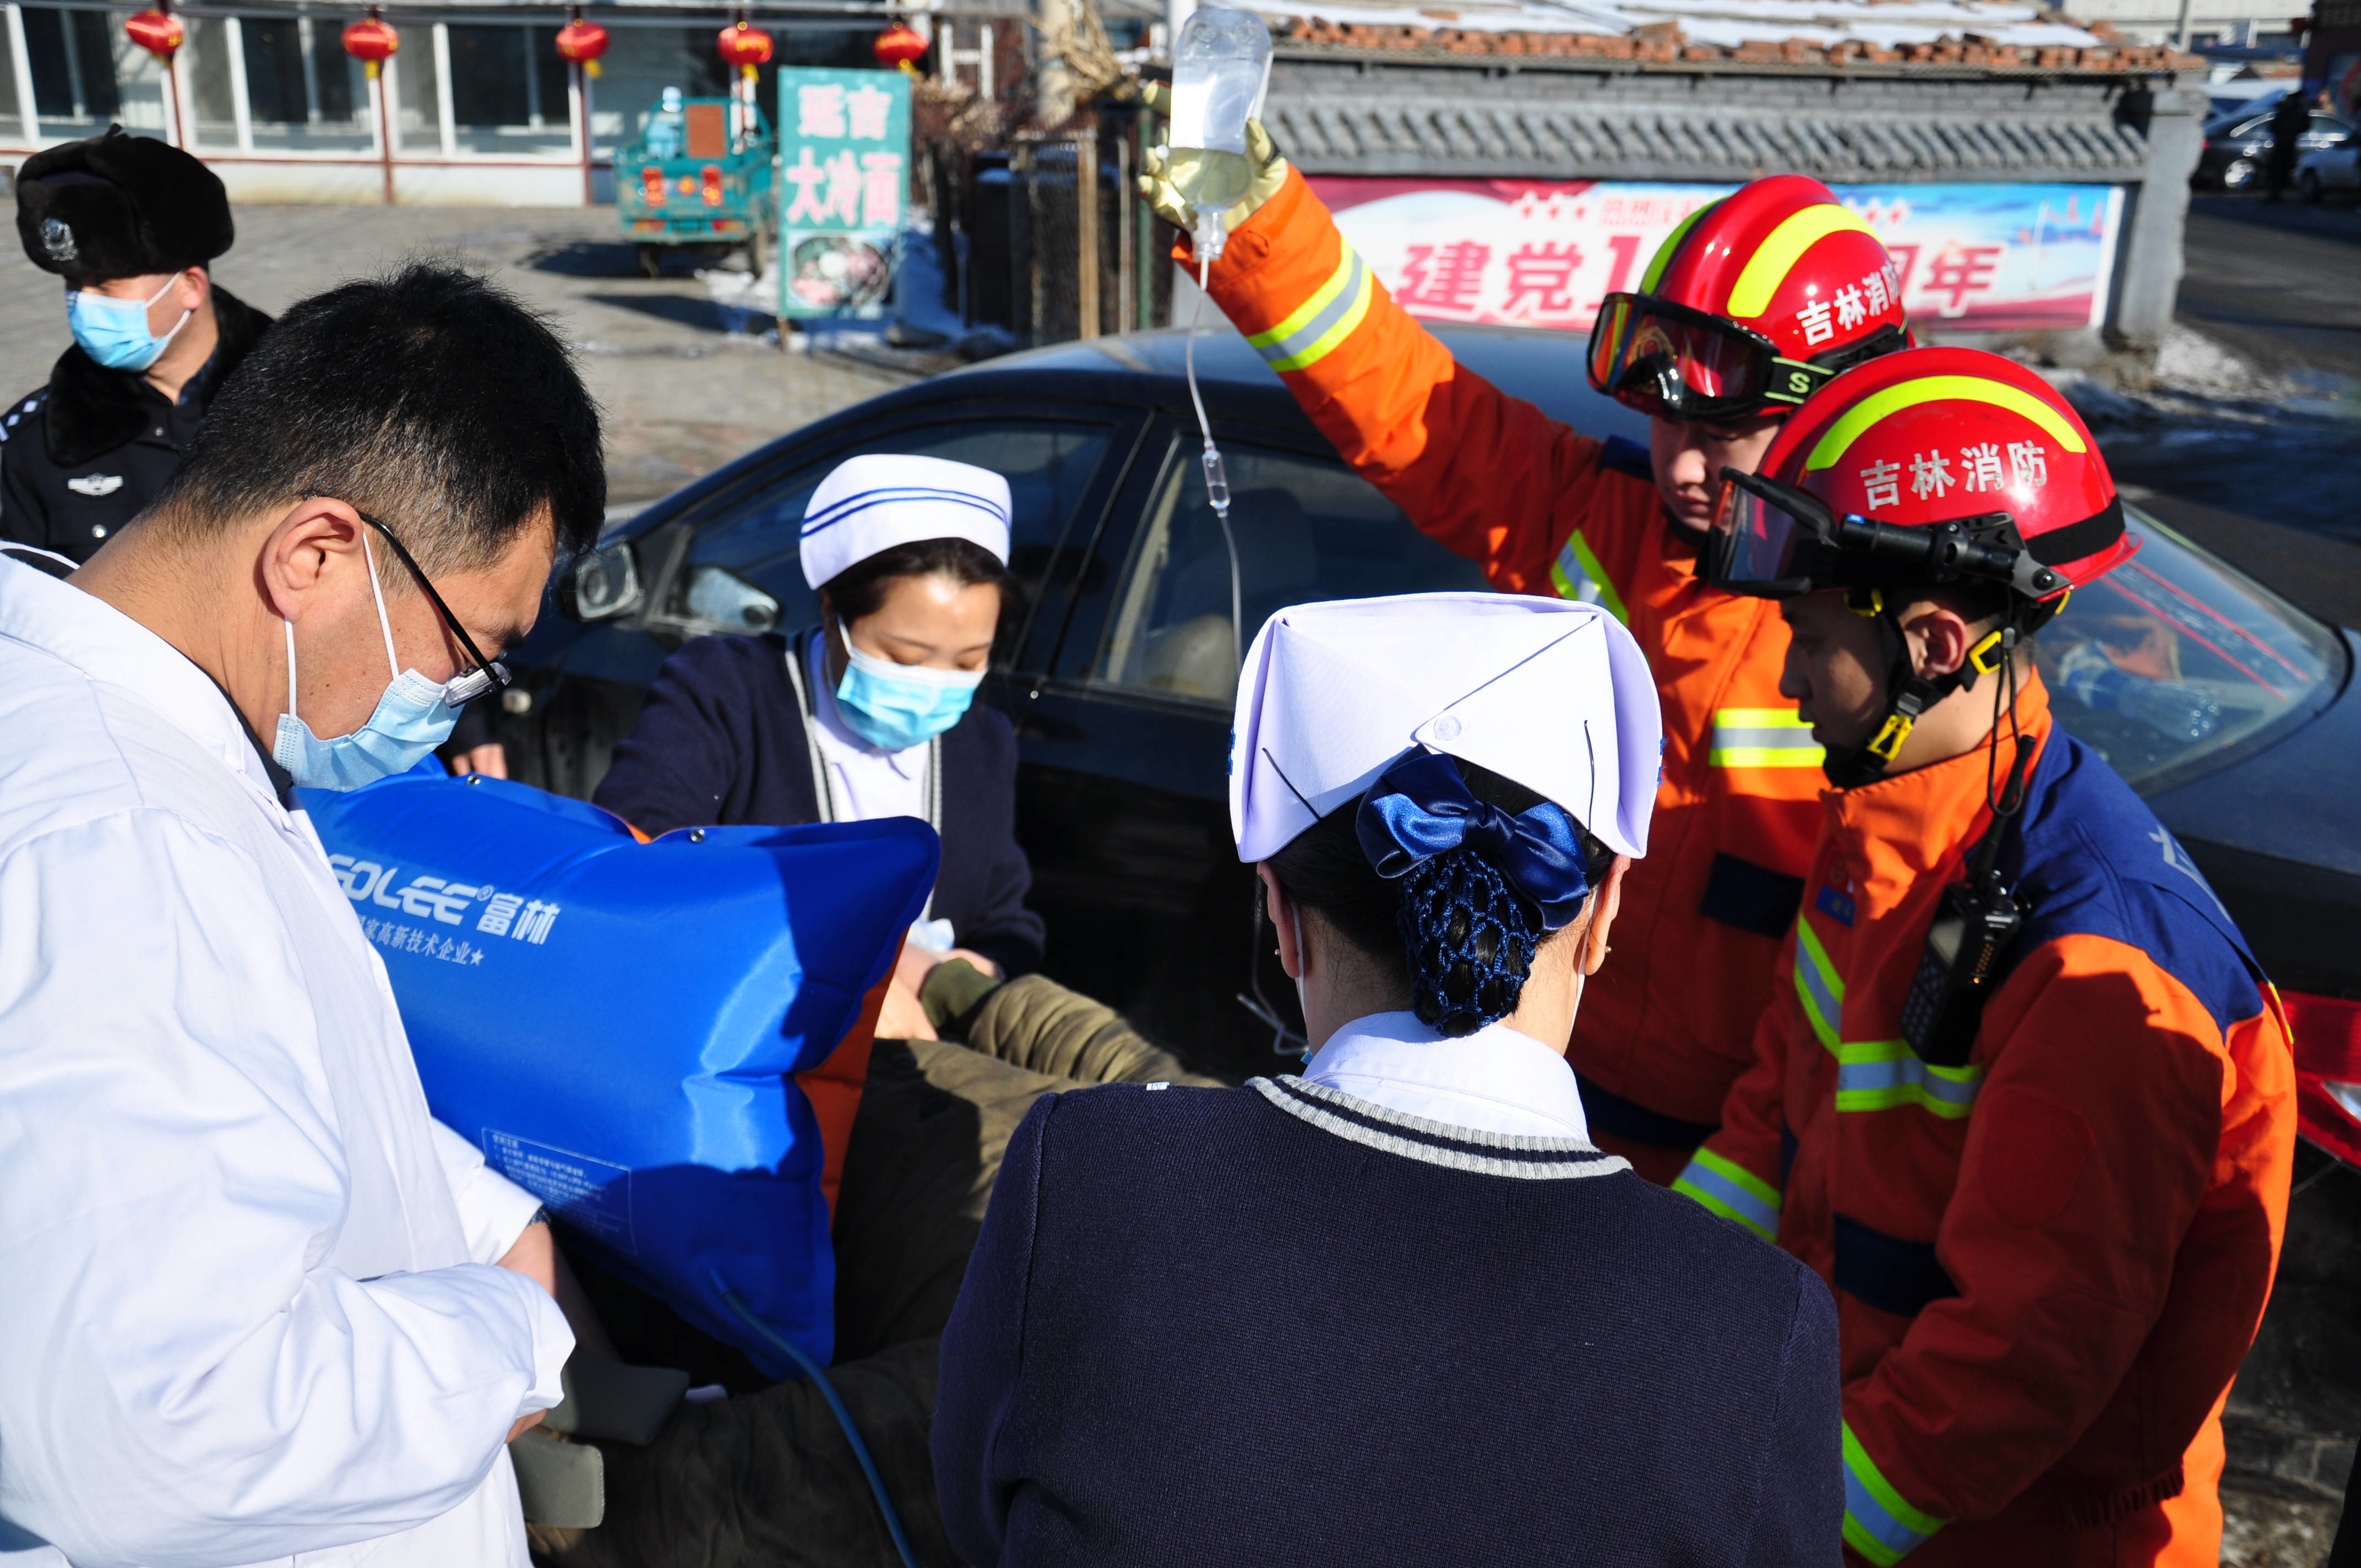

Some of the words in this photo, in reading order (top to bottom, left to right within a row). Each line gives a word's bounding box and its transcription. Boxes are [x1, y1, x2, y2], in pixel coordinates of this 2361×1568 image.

[786, 146, 902, 227] 大冷面
[1860, 439, 2047, 511] 吉林消防
[476, 892, 561, 945] 富林
